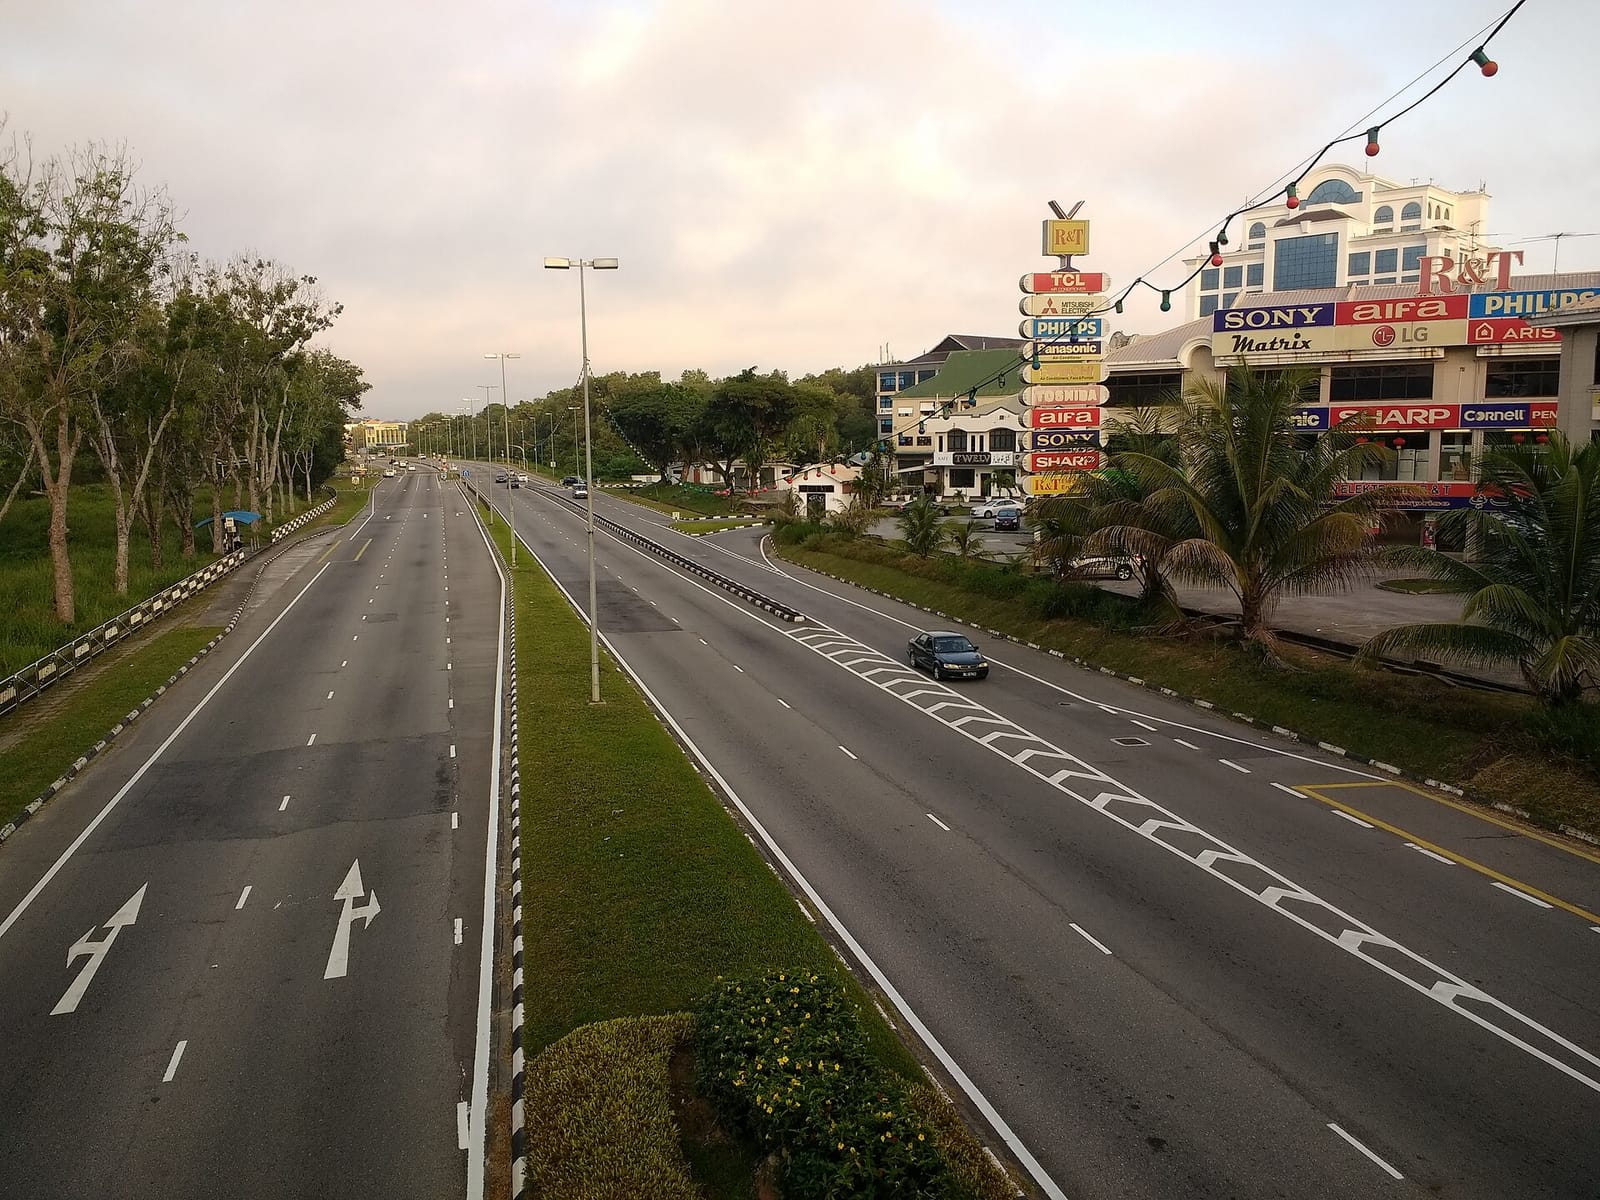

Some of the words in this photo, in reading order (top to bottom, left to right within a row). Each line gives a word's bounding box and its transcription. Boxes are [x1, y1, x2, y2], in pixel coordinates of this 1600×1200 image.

[1055, 228, 1084, 246] R&T
[1051, 273, 1086, 287] TCL
[1416, 250, 1525, 295] R&T
[1061, 307, 1091, 315] ELECTRIC
[1224, 307, 1323, 329] SONY
[1037, 321, 1097, 335] PHILPS
[1401, 326, 1428, 343] LG
[1037, 342, 1097, 354] Panasonic
[1231, 333, 1313, 353] Matrix
[1036, 389, 1098, 402] TOSHIBA
